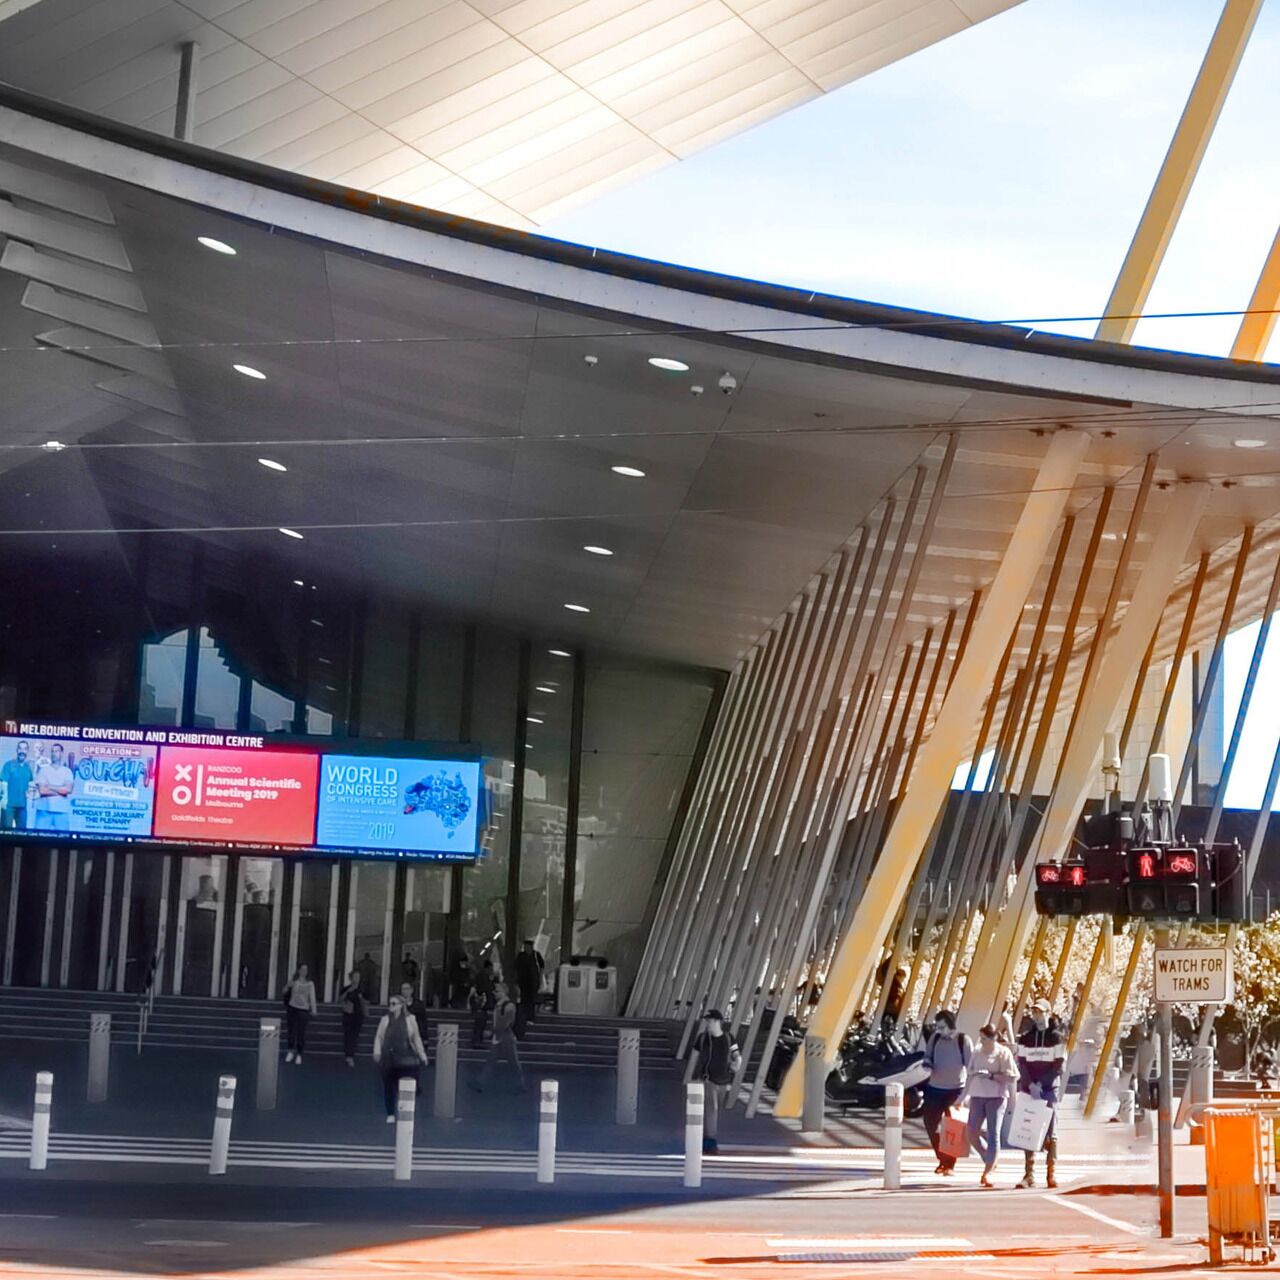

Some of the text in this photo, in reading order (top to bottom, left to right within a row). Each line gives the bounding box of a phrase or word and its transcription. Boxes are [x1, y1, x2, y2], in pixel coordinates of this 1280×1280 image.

[20, 723, 264, 748] MELBOURNE CONVENTION AND EXHIBITION CENTRE
[83, 746, 132, 756] OPERATION
[327, 764, 398, 785] WORLD
[206, 775, 302, 789] Annual Scientific
[206, 787, 278, 801] Meeting 2019
[327, 783, 398, 798] CONGRESS
[368, 821, 395, 841] 2019
[1159, 959, 1223, 972] WATCH FOR
[1173, 977, 1210, 991] TRAMS
